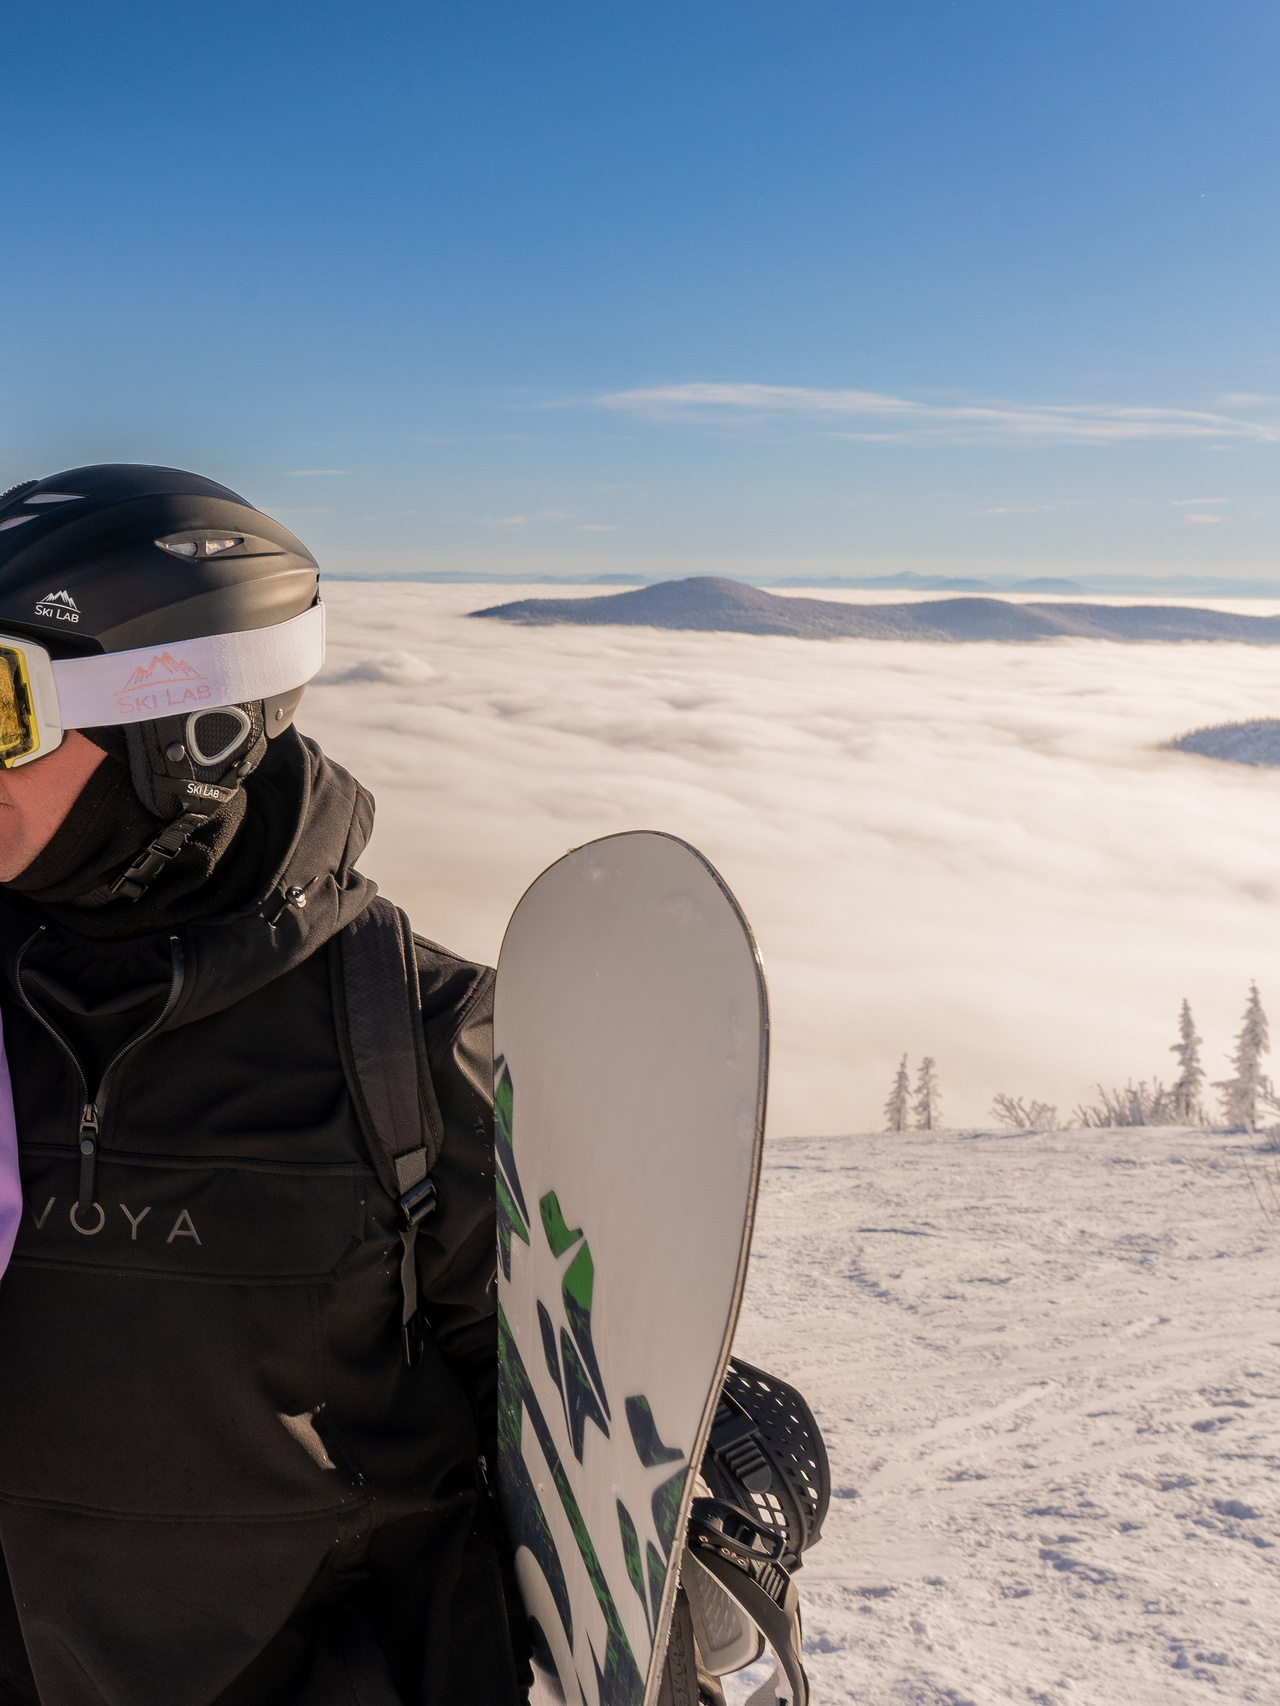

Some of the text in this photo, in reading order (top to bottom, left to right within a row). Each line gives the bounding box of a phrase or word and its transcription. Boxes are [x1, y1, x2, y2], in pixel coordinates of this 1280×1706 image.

[34, 604, 80, 623] SKI LAB
[117, 684, 212, 714] SKI LAB
[186, 783, 220, 798] SKI LAB
